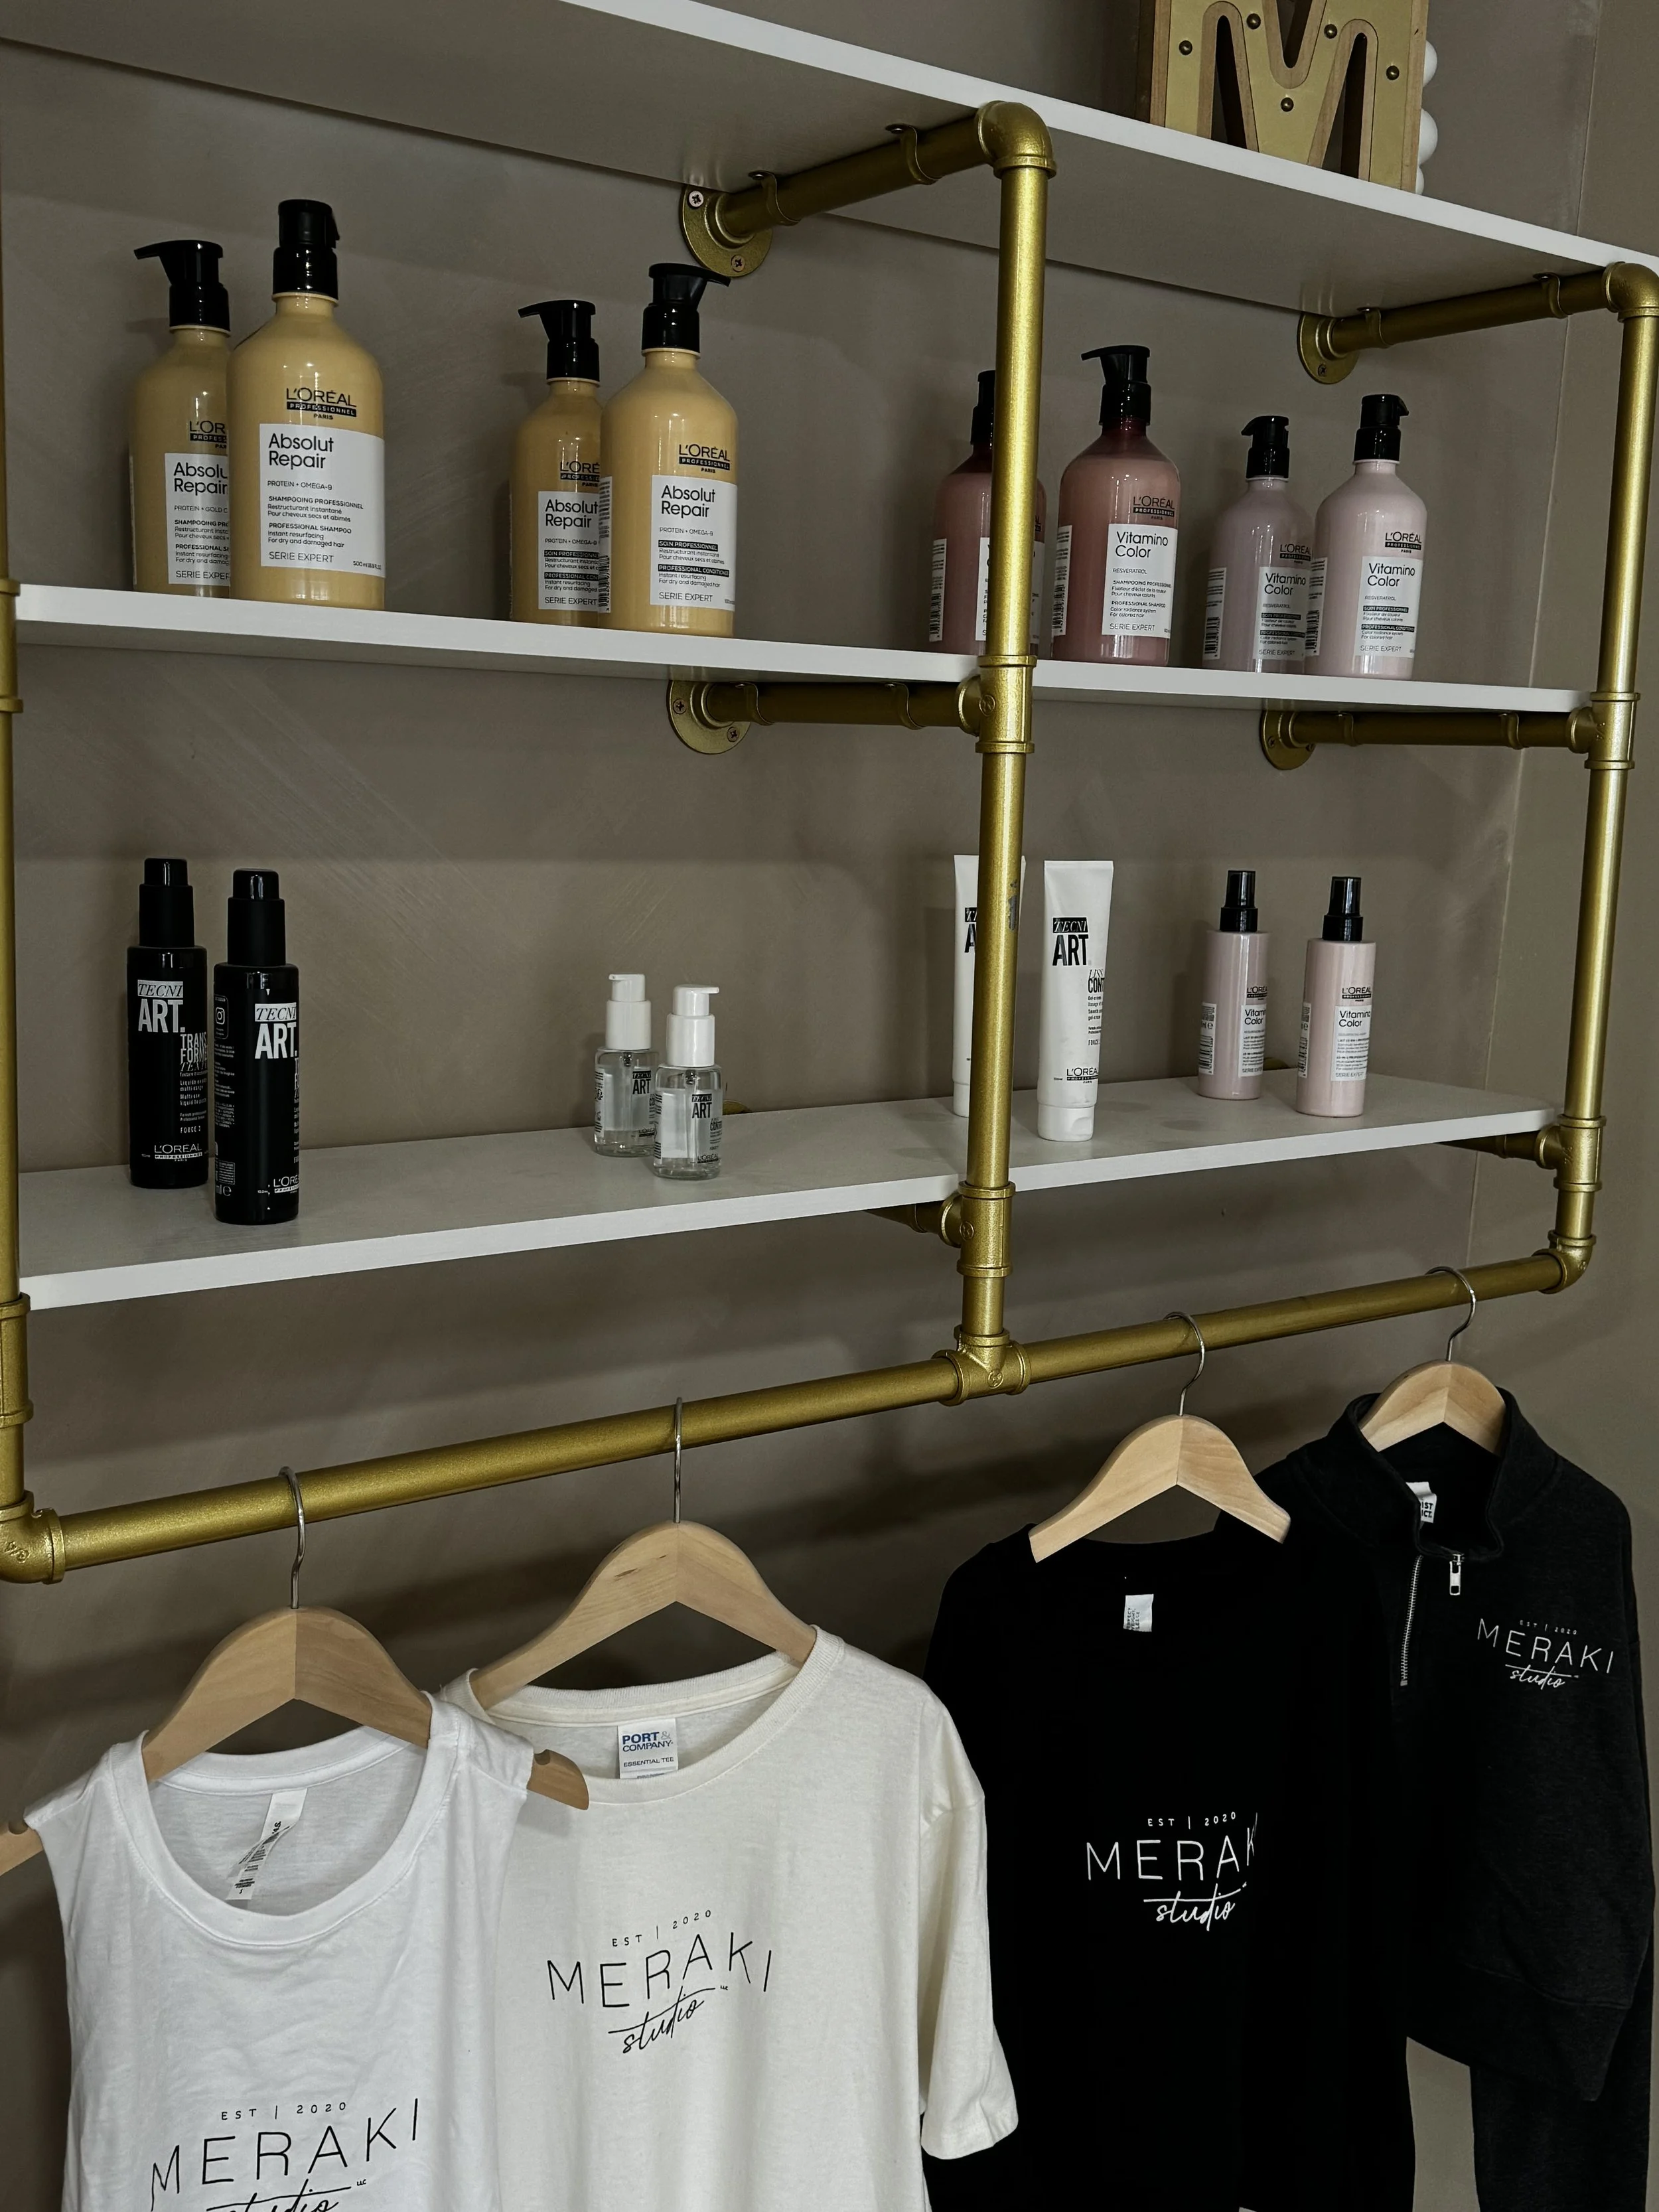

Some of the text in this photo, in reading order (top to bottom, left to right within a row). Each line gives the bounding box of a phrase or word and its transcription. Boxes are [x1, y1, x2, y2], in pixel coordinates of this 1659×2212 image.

[286, 387, 357, 407] L'ORÉAL
[289, 403, 355, 416] PROFESSIONNEL
[268, 433, 334, 452] Absolut
[679, 444, 730, 461] L'ORÉAL
[269, 451, 326, 470] Repair
[300, 482, 332, 490] OMEGA-9
[661, 484, 715, 502] Absolut
[315, 498, 364, 510] PROFESSIONNEL
[545, 498, 599, 514] Absolut
[661, 500, 710, 518] Repair
[269, 522, 352, 534] PROFESSIONAL SHAMPOO
[545, 514, 592, 530] Repair
[289, 532, 325, 540] resurfacing
[1116, 531, 1168, 546] Vitamino
[303, 540, 332, 548] damaged
[1116, 545, 1151, 558] Color
[269, 551, 334, 563] SERIE EXPERT
[658, 564, 702, 573] PROFESSIONAL
[1368, 562, 1415, 576] Vitamino
[1265, 573, 1306, 585] Vitamino
[1367, 575, 1400, 587] Color
[659, 591, 683, 600] SERIE
[685, 593, 713, 602] EXPERT
[1264, 584, 1293, 596] Color
[1054, 921, 1088, 933] TECNI
[138, 983, 183, 997] TECNI
[256, 1006, 297, 1021] TECNI
[1244, 1017, 1264, 1025] Color
[1338, 1019, 1362, 1027] Color
[632, 1079, 651, 1095] ART
[691, 1102, 712, 1119] ART
[1477, 1618, 1614, 1674] MERAKI
[1510, 1664, 1565, 1690] studio
[622, 1730, 672, 1745] PORT &
[1147, 1818, 1175, 1826] EST
[1204, 1811, 1236, 1826] 2020
[1155, 1882, 1236, 1931] studio
[612, 1934, 642, 1947] EST
[672, 1909, 711, 1930] 2020
[547, 1932, 772, 2008] MERAKI
[622, 1984, 705, 2054] studio
[221, 2108, 257, 2120] EST
[296, 2102, 346, 2114] 2020
[151, 2098, 418, 2212] MERAKI
